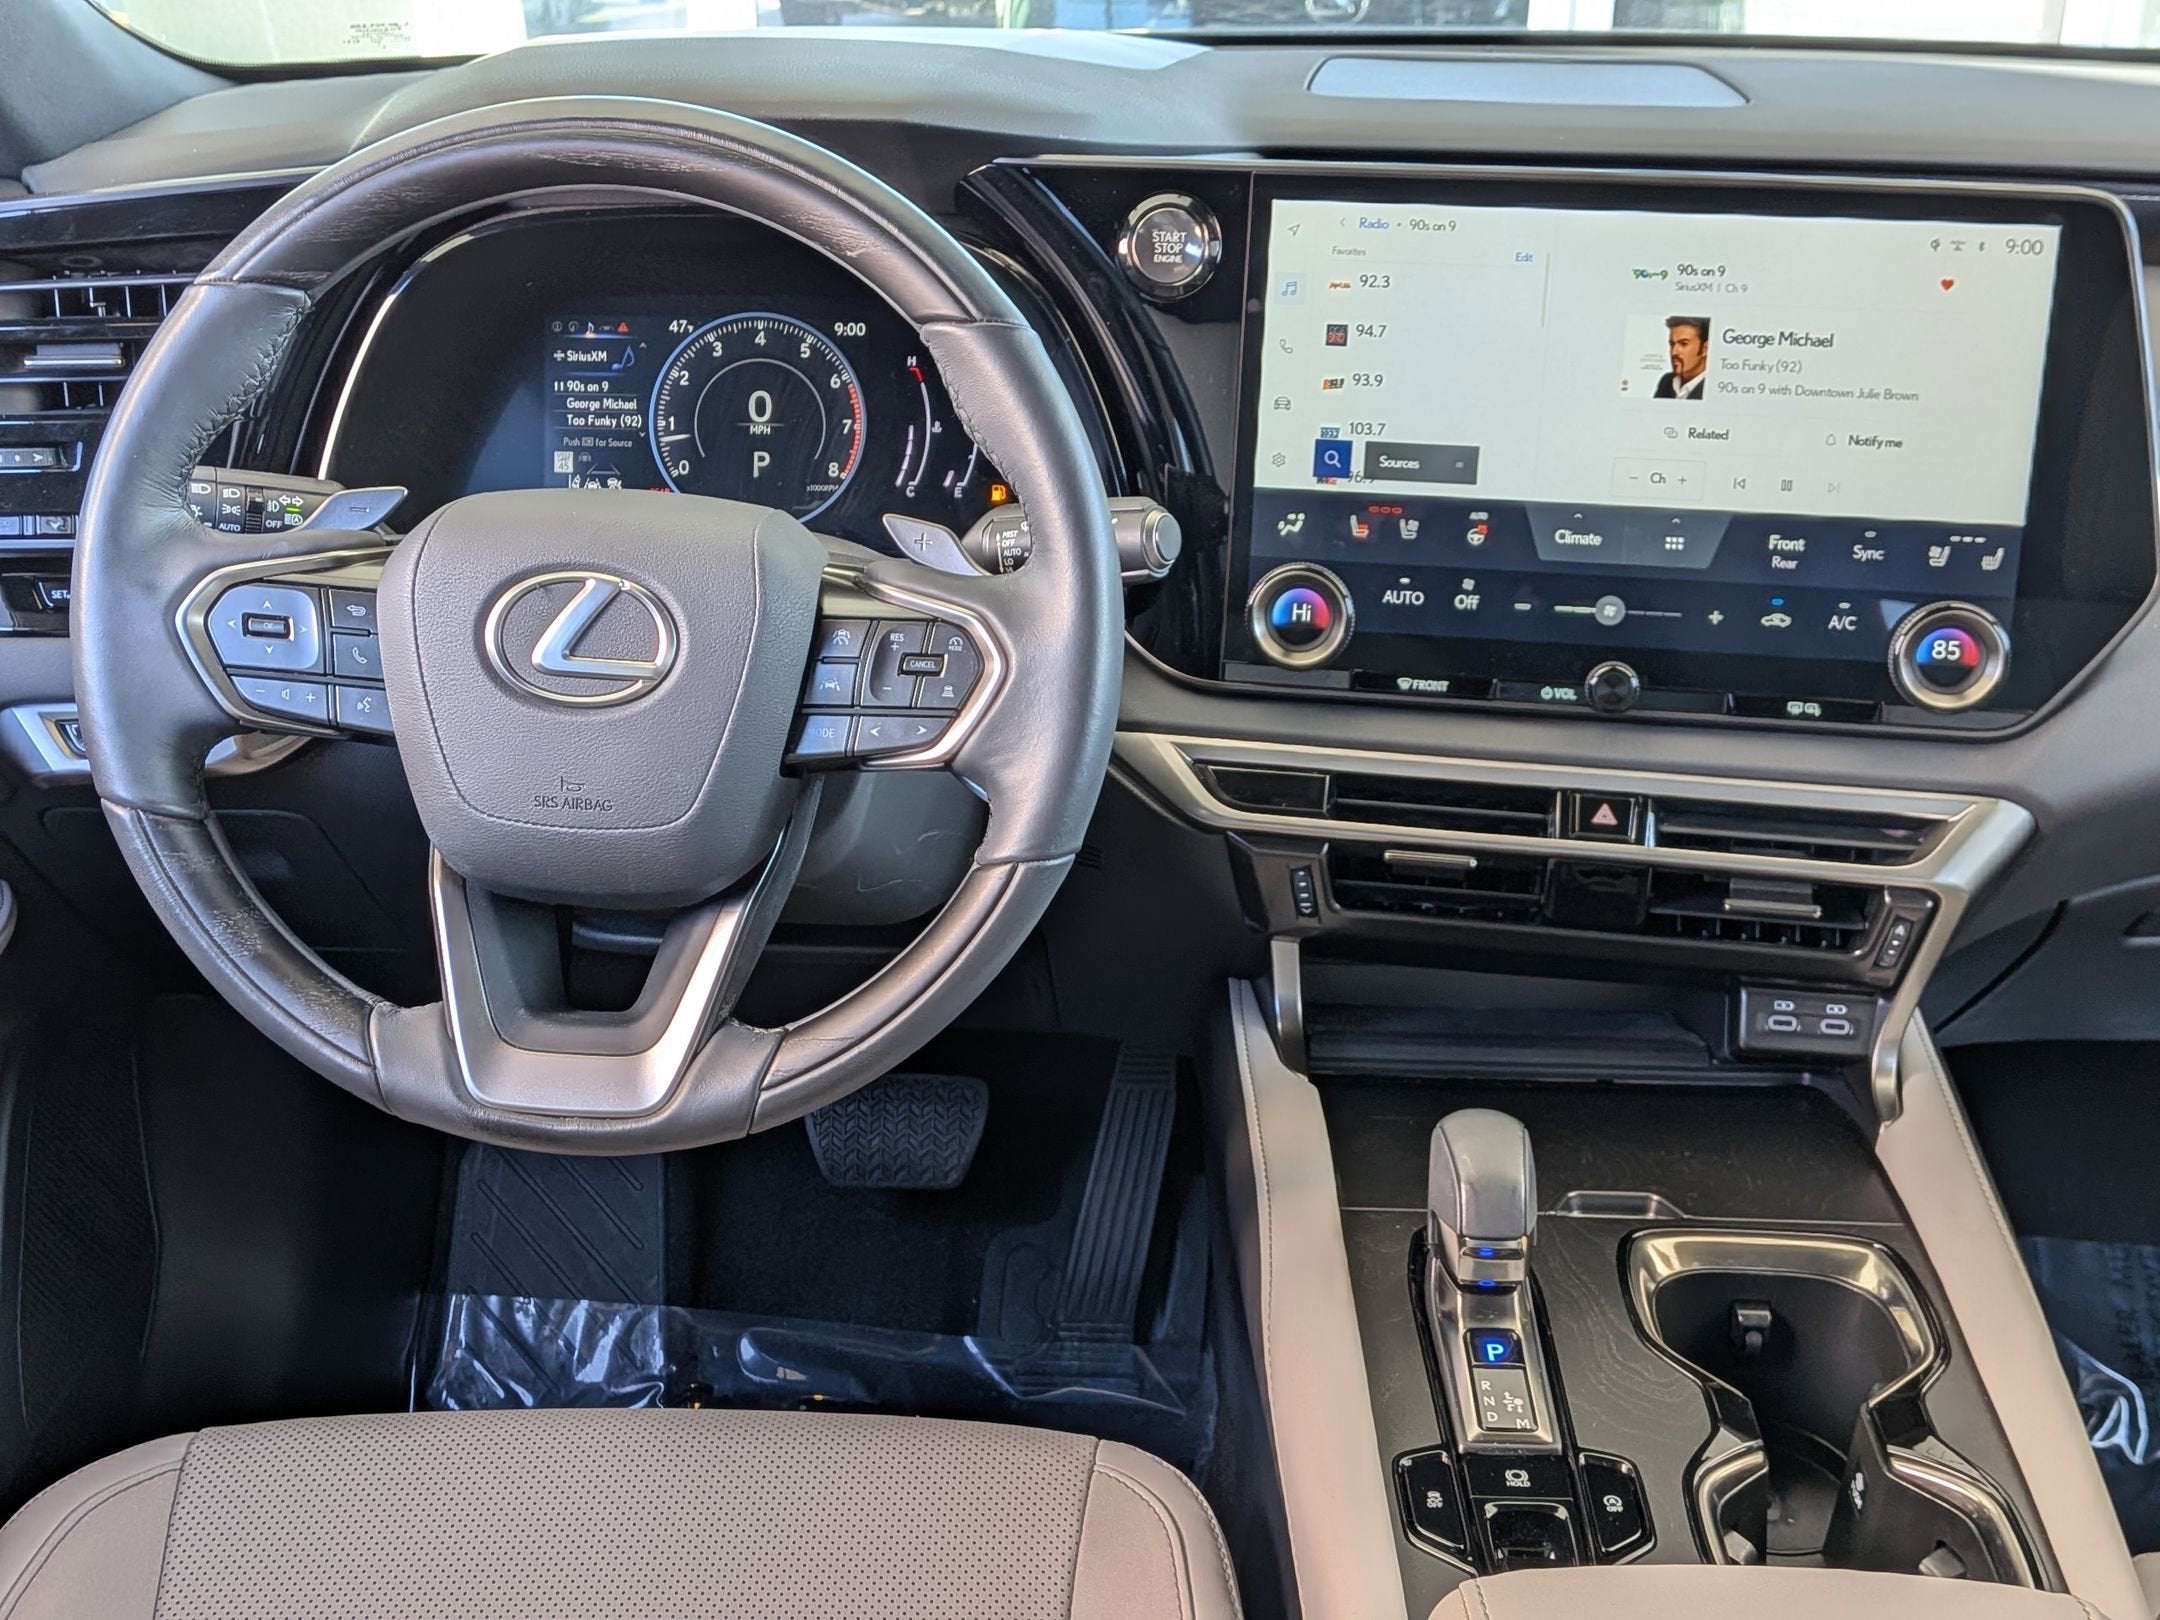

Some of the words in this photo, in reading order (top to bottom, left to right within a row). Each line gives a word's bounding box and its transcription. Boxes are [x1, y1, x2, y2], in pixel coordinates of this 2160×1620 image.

[1359, 217, 1390, 229] Radio
[1409, 219, 1430, 231] 90s
[1432, 223, 1446, 231] on
[1448, 220, 1457, 232] 9
[1152, 231, 1187, 243] START
[1154, 242, 1184, 254] STOP
[1332, 246, 1367, 256] Favorites
[2005, 238, 2044, 256] 9:00
[1153, 255, 1183, 263] ENGINE
[1515, 252, 1533, 262] Edit
[1677, 264, 1698, 276] 90s
[1701, 268, 1715, 276] on
[1717, 265, 1726, 277] 9
[1359, 274, 1391, 289] 92.3
[1675, 281, 1713, 292] SiriusXM
[1725, 283, 1738, 293] Ch
[1740, 284, 1748, 293] 9
[833, 322, 866, 337] 9:00
[1355, 323, 1387, 338] 94.7
[754, 331, 767, 346] 4
[1722, 328, 1775, 349] George
[1778, 331, 1834, 348] Michael
[712, 341, 723, 357] 3
[800, 343, 811, 358] 5
[566, 350, 607, 363] SiriusXM
[906, 355, 918, 366] H
[1720, 358, 1739, 370] Too
[1742, 359, 1774, 374] Funky
[1775, 360, 1803, 374] (92)
[679, 370, 690, 386] 2
[830, 372, 841, 389] 6
[1352, 373, 1384, 388] 93.9
[566, 380, 585, 392] 90s
[587, 383, 599, 392] on
[601, 381, 609, 392] 9
[1717, 381, 1739, 393] 90s
[1741, 386, 1755, 394] on
[1757, 383, 1766, 394] 9
[1768, 386, 1792, 396] with
[1795, 385, 1854, 398] Downtown
[1856, 388, 1881, 400] Julie
[1883, 388, 1919, 401] Brown
[566, 397, 600, 411] George
[602, 398, 638, 410] Michael
[748, 390, 773, 423] 0
[566, 414, 585, 426] Too
[588, 414, 617, 429] Funky
[620, 414, 642, 428] (92)
[668, 415, 676, 431] 1
[842, 419, 852, 434] 7
[749, 424, 771, 435] MPH
[1349, 422, 1386, 436] 103.7
[1687, 427, 1729, 440] Related
[563, 437, 580, 446] Push
[595, 438, 606, 446] for
[608, 438, 633, 447] Source
[1848, 434, 1883, 449] Notify
[1884, 440, 1903, 448] me
[678, 459, 690, 475] 0
[753, 451, 770, 478] P
[1379, 455, 1420, 469] Sources
[828, 462, 839, 478] 8
[1650, 472, 1666, 484] Ch
[906, 487, 916, 497] C
[954, 488, 962, 498] E
[1469, 512, 1489, 520] AUTO
[219, 523, 241, 532] AUTO
[265, 520, 282, 528] OFF
[1002, 530, 1018, 539] MIST
[1555, 529, 1602, 546] Climate
[1002, 539, 1015, 547] OFF
[1768, 534, 1806, 551] Front
[1003, 548, 1022, 557] AUTO
[1852, 544, 1885, 562] Sync
[1004, 558, 1014, 566] LO
[1771, 556, 1799, 570] Rear
[51, 590, 67, 599] SET
[1382, 590, 1425, 605] AUTO
[1454, 594, 1481, 611] Off
[1291, 602, 1312, 623] Hi
[1828, 615, 1858, 631] A/C
[890, 633, 905, 642] RES
[1931, 639, 1962, 662] 85
[909, 660, 936, 669] CANCEL
[1412, 678, 1450, 693] FRONT
[1553, 687, 1578, 701] VOL
[534, 795, 559, 809] SRS
[561, 796, 613, 812] AIRBAG
[1486, 1344, 1504, 1361] P
[1481, 1380, 1491, 1391] R
[1483, 1396, 1495, 1406] N
[1486, 1411, 1498, 1422] D
[1516, 1418, 1531, 1430] M
[1506, 1480, 1531, 1488] HOLD
